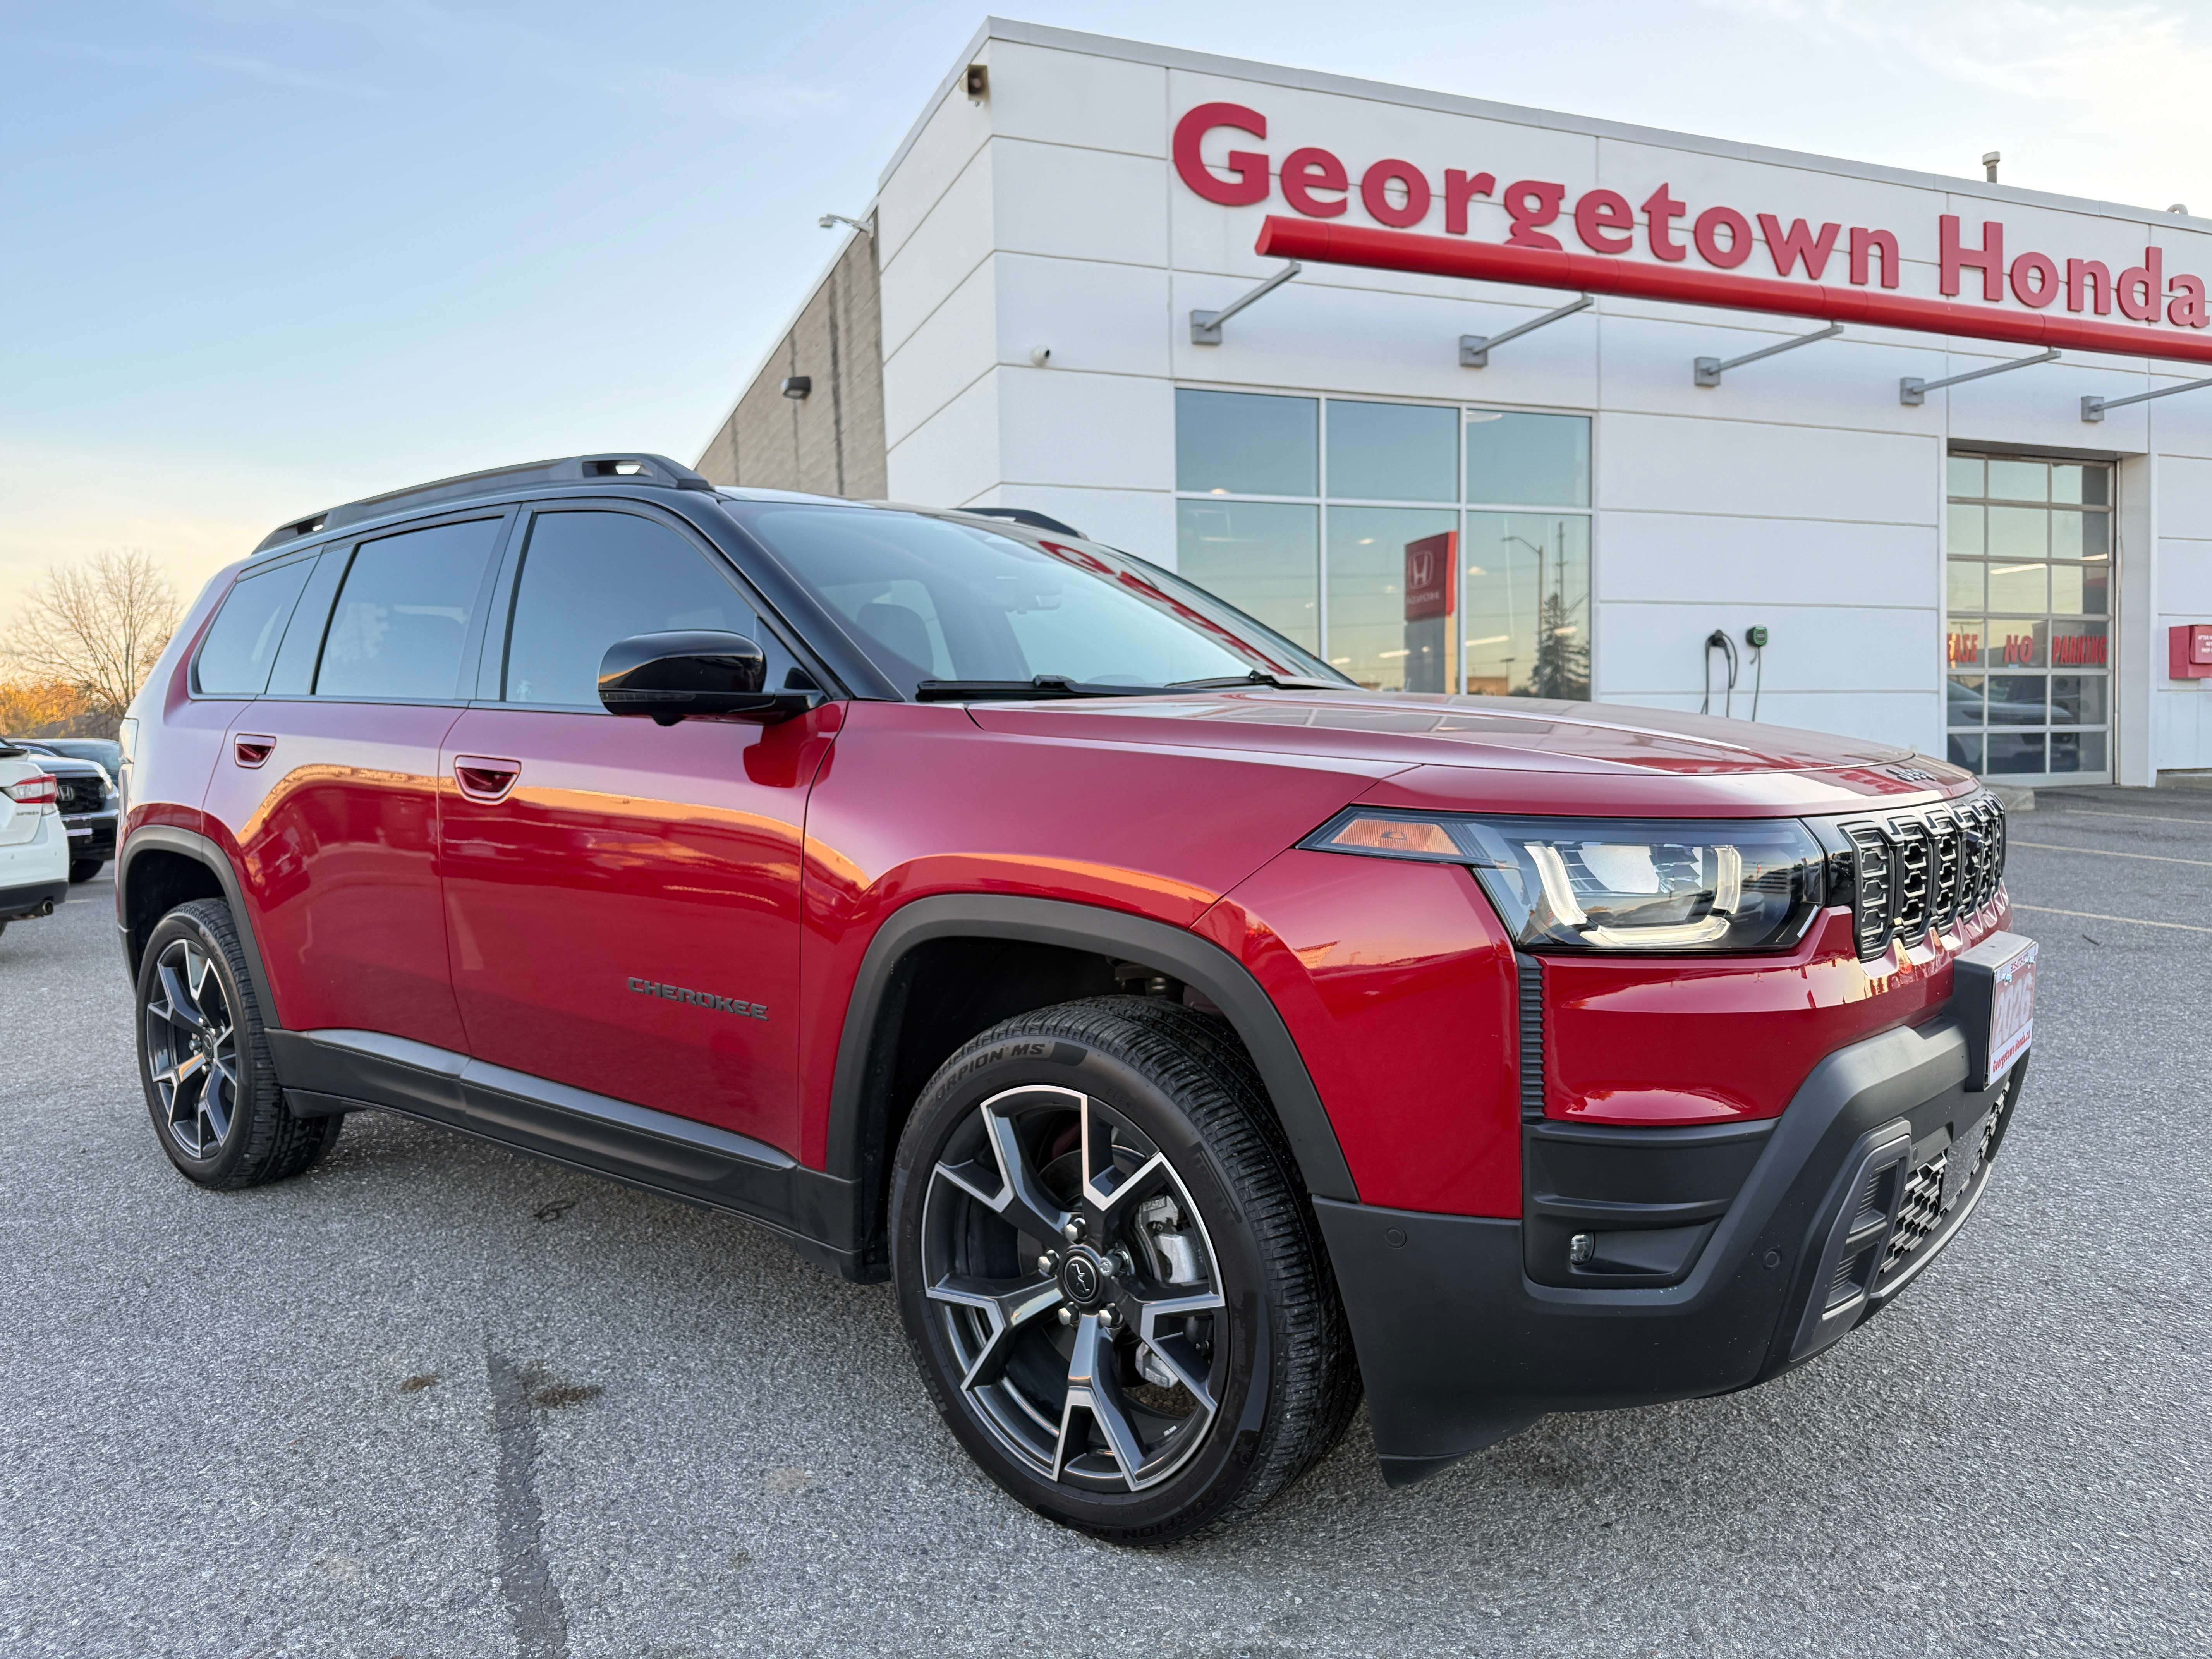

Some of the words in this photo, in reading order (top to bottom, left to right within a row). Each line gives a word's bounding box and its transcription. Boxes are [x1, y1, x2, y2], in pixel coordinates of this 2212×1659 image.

[1173, 102, 1899, 289] Georgetown
[1939, 214, 2210, 328] Honda
[2004, 634, 2033, 663] NO
[2053, 635, 2107, 664] PARKING
[627, 977, 769, 1021] CHEROKEE
[1011, 1043, 1045, 1056] MS
